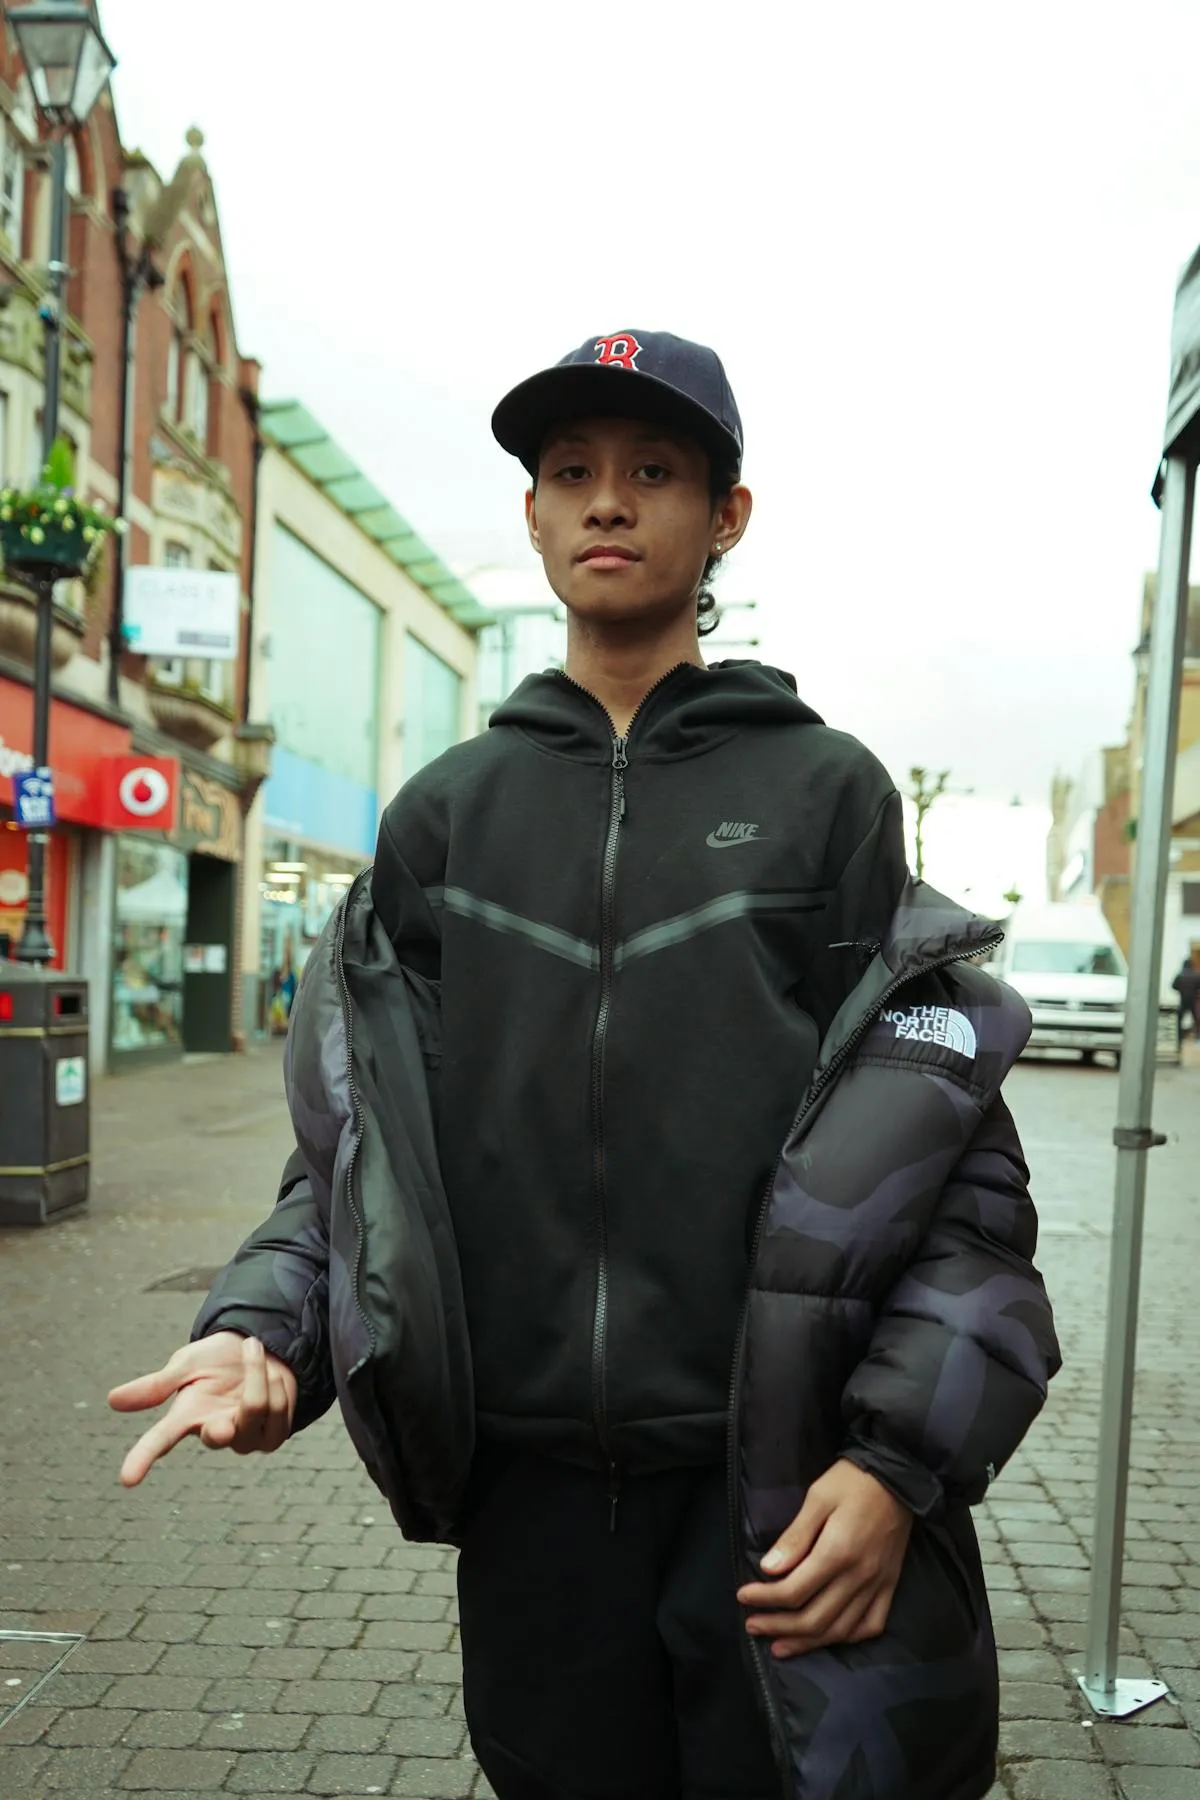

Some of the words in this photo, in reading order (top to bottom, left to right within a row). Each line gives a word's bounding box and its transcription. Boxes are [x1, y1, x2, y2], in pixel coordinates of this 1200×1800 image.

[715, 821, 759, 838] NIKE
[879, 1008, 948, 1032] NORTH
[909, 1005, 949, 1019] THE
[895, 1026, 948, 1045] FACE
